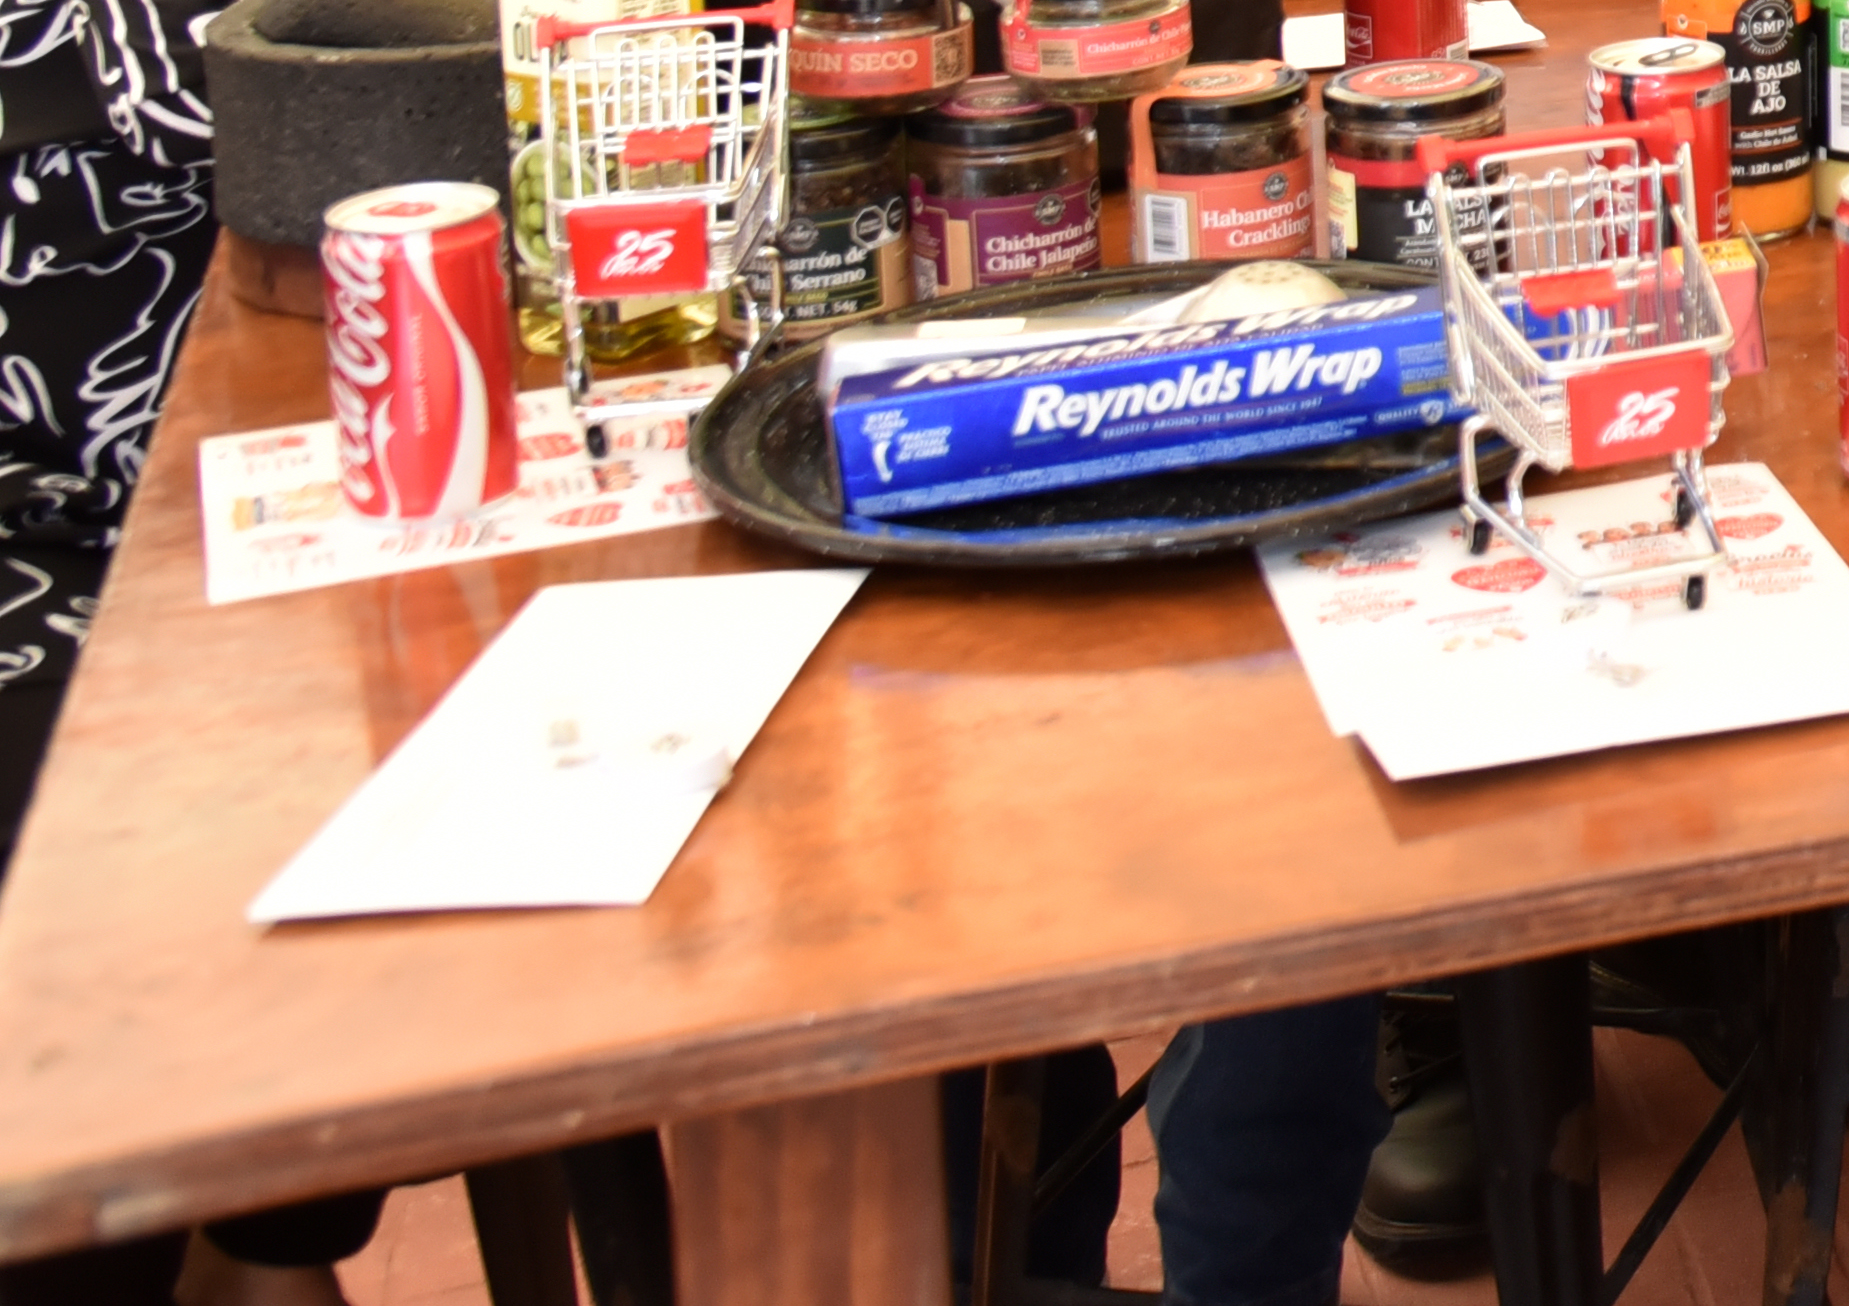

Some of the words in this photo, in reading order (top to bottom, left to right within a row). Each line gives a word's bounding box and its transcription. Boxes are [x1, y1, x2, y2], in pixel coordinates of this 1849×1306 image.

[1753, 16, 1785, 36] SMP
[1087, 37, 1148, 54] Chicharrón
[789, 48, 843, 73] QUÍN
[849, 48, 918, 72] SECO
[1729, 65, 1751, 82] LA
[1755, 59, 1802, 81] SALSA
[1757, 80, 1781, 96] DE
[1752, 96, 1786, 115] AJO
[1750, 162, 1769, 175] 12fl
[1772, 161, 1784, 173] oz
[1201, 201, 1294, 229] Habanero
[1405, 200, 1434, 217] LA
[1415, 210, 1487, 235] MCHA
[614, 229, 677, 271] 25
[985, 223, 1082, 255] Chicharrón
[844, 245, 868, 265] de
[985, 253, 1037, 272] Chile
[791, 268, 867, 291] Serrano
[893, 322, 1227, 389] Reynolds
[1233, 294, 1418, 334] Wrap
[1012, 361, 1246, 437] Reynolds
[1250, 343, 1382, 395] Wrap
[1103, 422, 1149, 439] TRUSTED
[1152, 413, 1199, 430] AROUND
[1203, 411, 1221, 423] THE
[1225, 407, 1264, 420] WORLD
[1267, 402, 1297, 417] SINCE
[1300, 397, 1323, 410] 1947
[1377, 408, 1418, 423] QUALITY
[1618, 386, 1680, 427] 25
